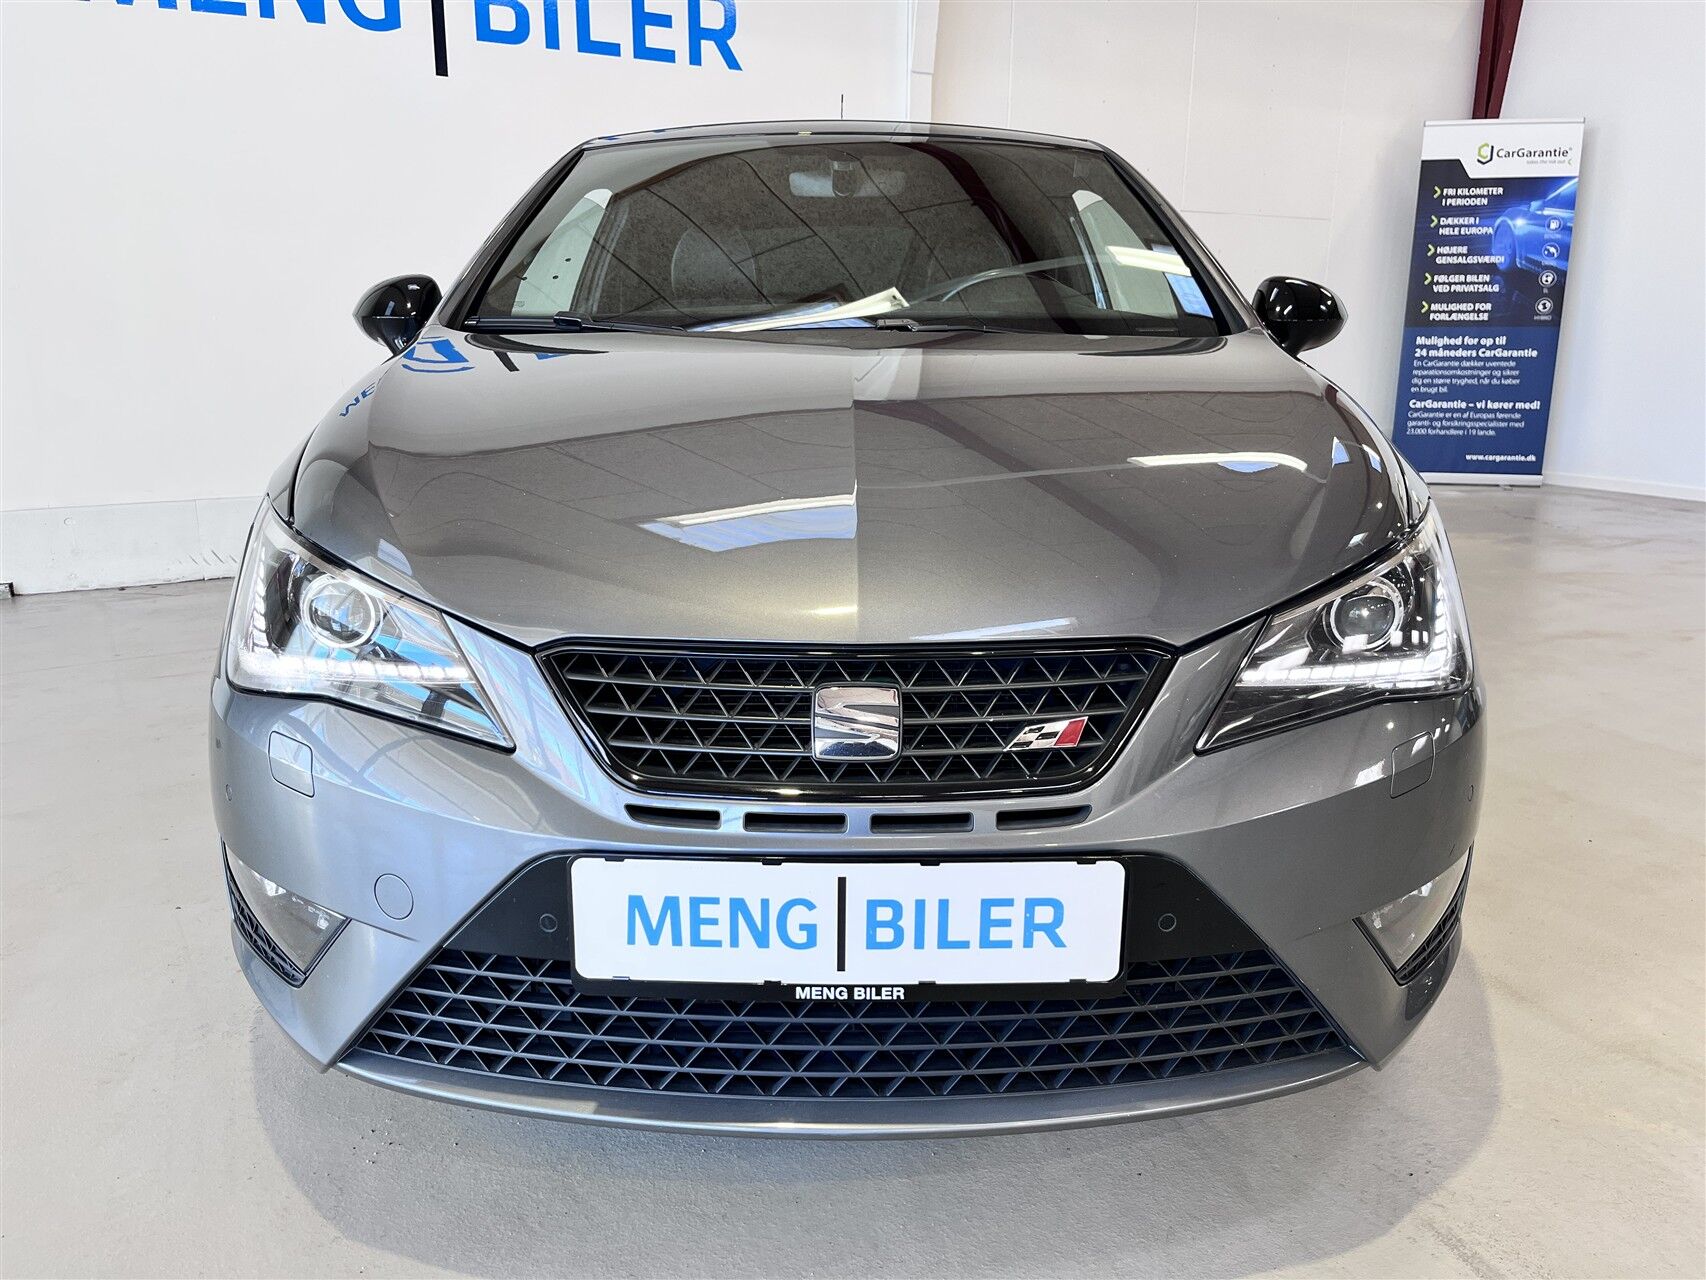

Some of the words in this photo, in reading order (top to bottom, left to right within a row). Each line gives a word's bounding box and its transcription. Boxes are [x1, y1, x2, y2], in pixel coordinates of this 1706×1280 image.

[1496, 147, 1569, 158] CarGarantie
[1443, 187, 1456, 196] FRI
[1457, 187, 1504, 196] KILOMETER
[1446, 197, 1488, 206] PERIODEN
[1440, 217, 1474, 225] DÆKKER
[1439, 227, 1460, 235] HELE
[1460, 226, 1493, 235] EUROPA
[1436, 245, 1468, 254] HØJERE
[1436, 255, 1505, 264] GENSALGSVÆRDI
[1433, 274, 1465, 282] FØLGER
[1466, 274, 1490, 282] BILEN
[1433, 284, 1449, 292] VED
[1450, 284, 1499, 292] PRIVATSALG
[1430, 303, 1473, 311] MULIGHED
[1474, 303, 1492, 311] FOR
[1430, 312, 1488, 321] FORLÆNGELSE
[1416, 336, 1462, 347] Mulighed
[1464, 336, 1478, 345] for
[1480, 337, 1494, 347] op
[1495, 336, 1506, 345] til
[1414, 348, 1427, 357] 24
[1429, 348, 1477, 357] måneders
[1478, 348, 1538, 357] CarGarantie
[1409, 399, 1467, 408] CarGarantie
[1475, 400, 1485, 409] vi
[1487, 400, 1514, 409] kører
[1515, 400, 1540, 410] med!
[1465, 454, 1536, 462] www.cargarantie.dk
[626, 894, 819, 951] MENG
[864, 896, 1067, 951] BILER
[795, 986, 849, 1001] MENG
[853, 986, 905, 1001] BILER
